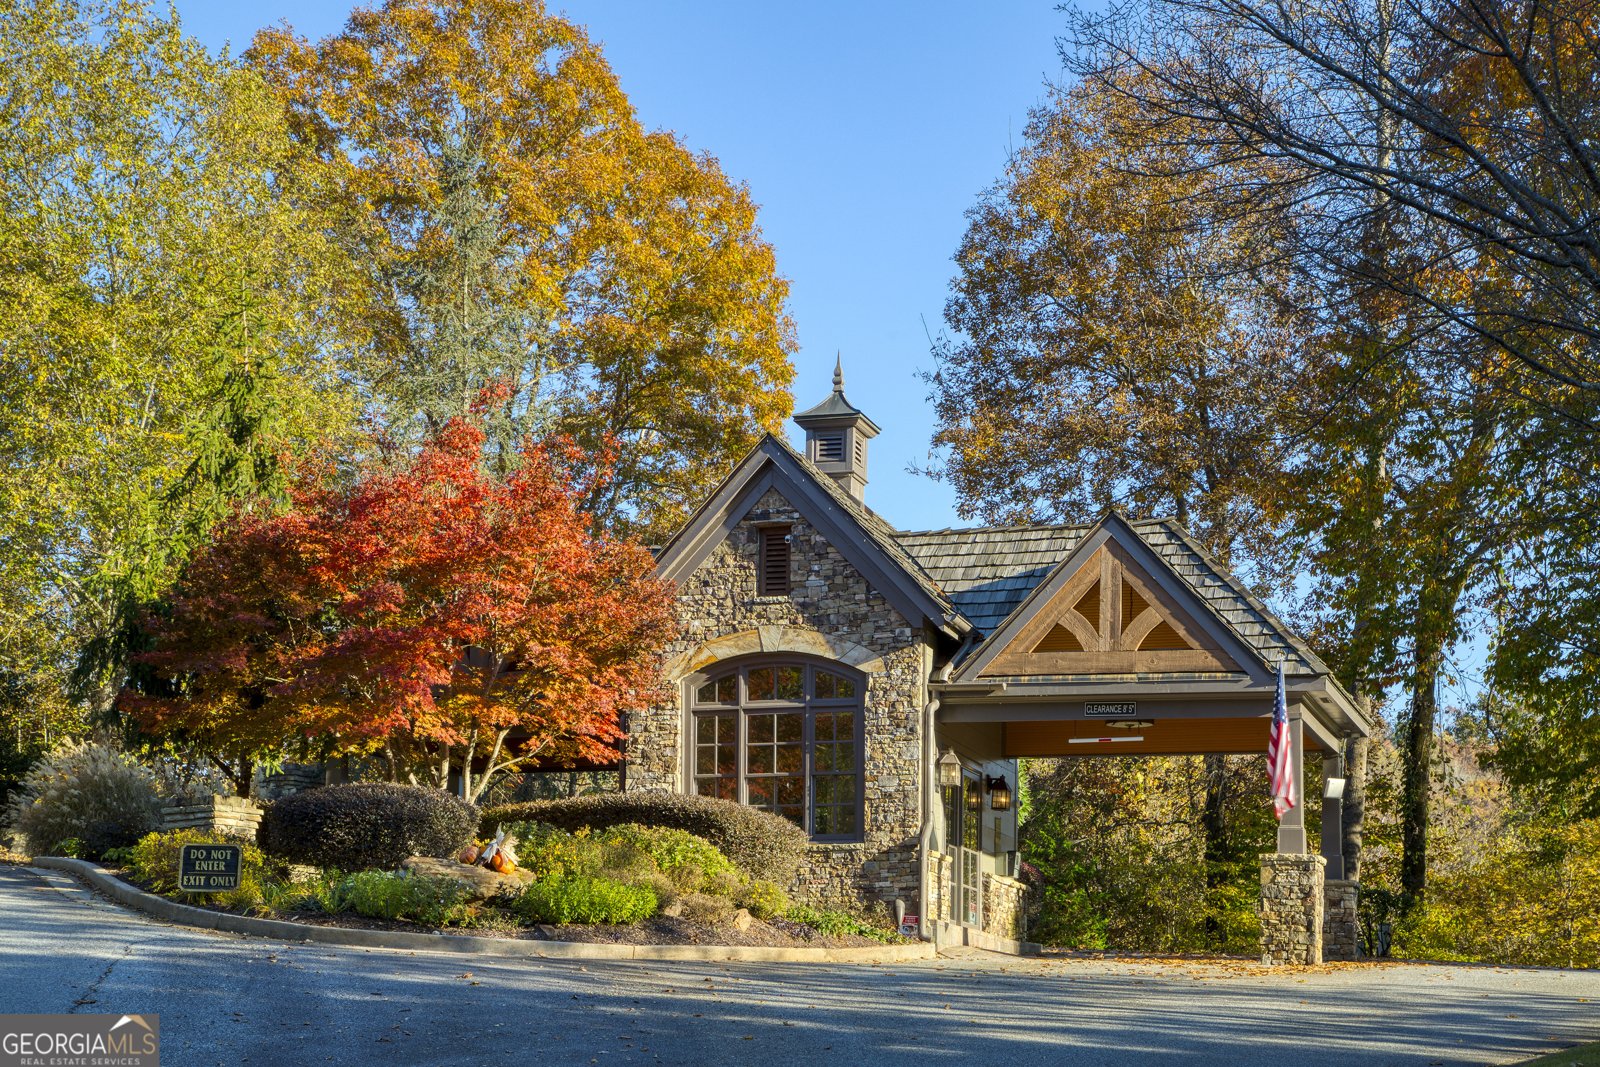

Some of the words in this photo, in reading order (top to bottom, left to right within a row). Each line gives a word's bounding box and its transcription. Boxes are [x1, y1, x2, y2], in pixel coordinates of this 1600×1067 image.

[1086, 704, 1122, 713] CLEARANCE
[190, 849, 207, 859] DO
[210, 849, 232, 860] NOT
[195, 860, 226, 871] ENTER
[182, 875, 206, 886] EXIT
[209, 876, 236, 887] ONLY
